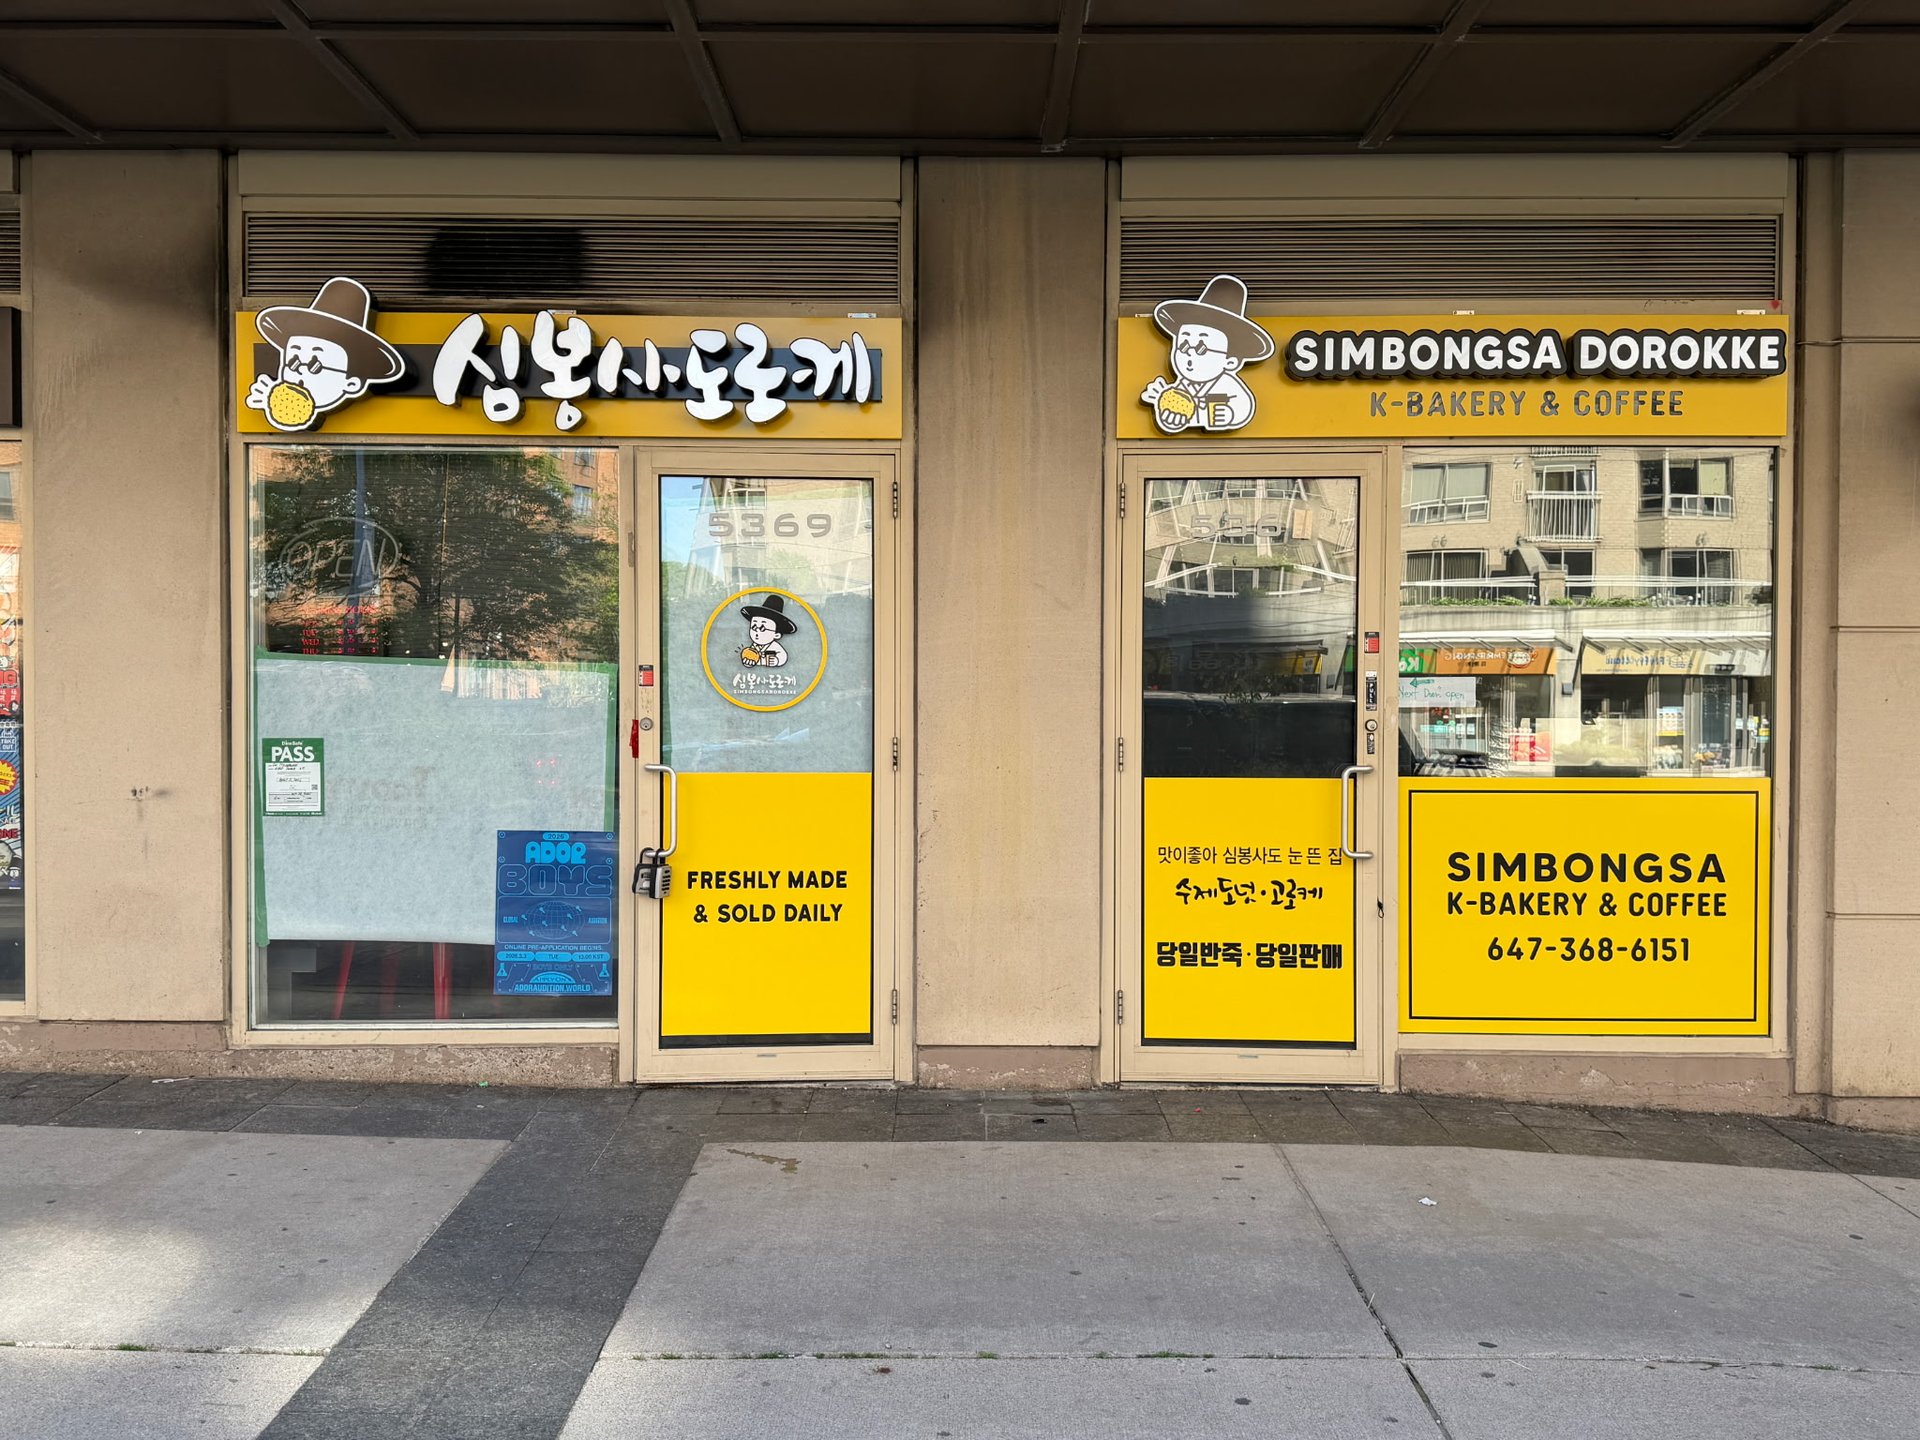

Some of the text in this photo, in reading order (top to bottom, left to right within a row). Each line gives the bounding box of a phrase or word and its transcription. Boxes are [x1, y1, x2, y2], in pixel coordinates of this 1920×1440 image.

[1294, 334, 1781, 372] SIMBONGSA DOROKKE
[1370, 390, 1683, 417] K-BAKERY & COFFEE
[708, 513, 832, 538] 5369
[287, 538, 386, 579] OPEN
[271, 746, 315, 762] PASS
[525, 841, 586, 864] ADOR
[1157, 846, 1343, 866] 맛이좋아 심봉사도 눈 뜬 집
[498, 864, 613, 896] BOYS
[687, 870, 848, 889] FRESHLY MADE
[1447, 851, 1726, 883] SIMBONGSA
[693, 903, 843, 923] & SOLD DAILY
[1447, 891, 1728, 917] K-BAKERY & COFFEE
[1487, 936, 1690, 962] 647-368-6151
